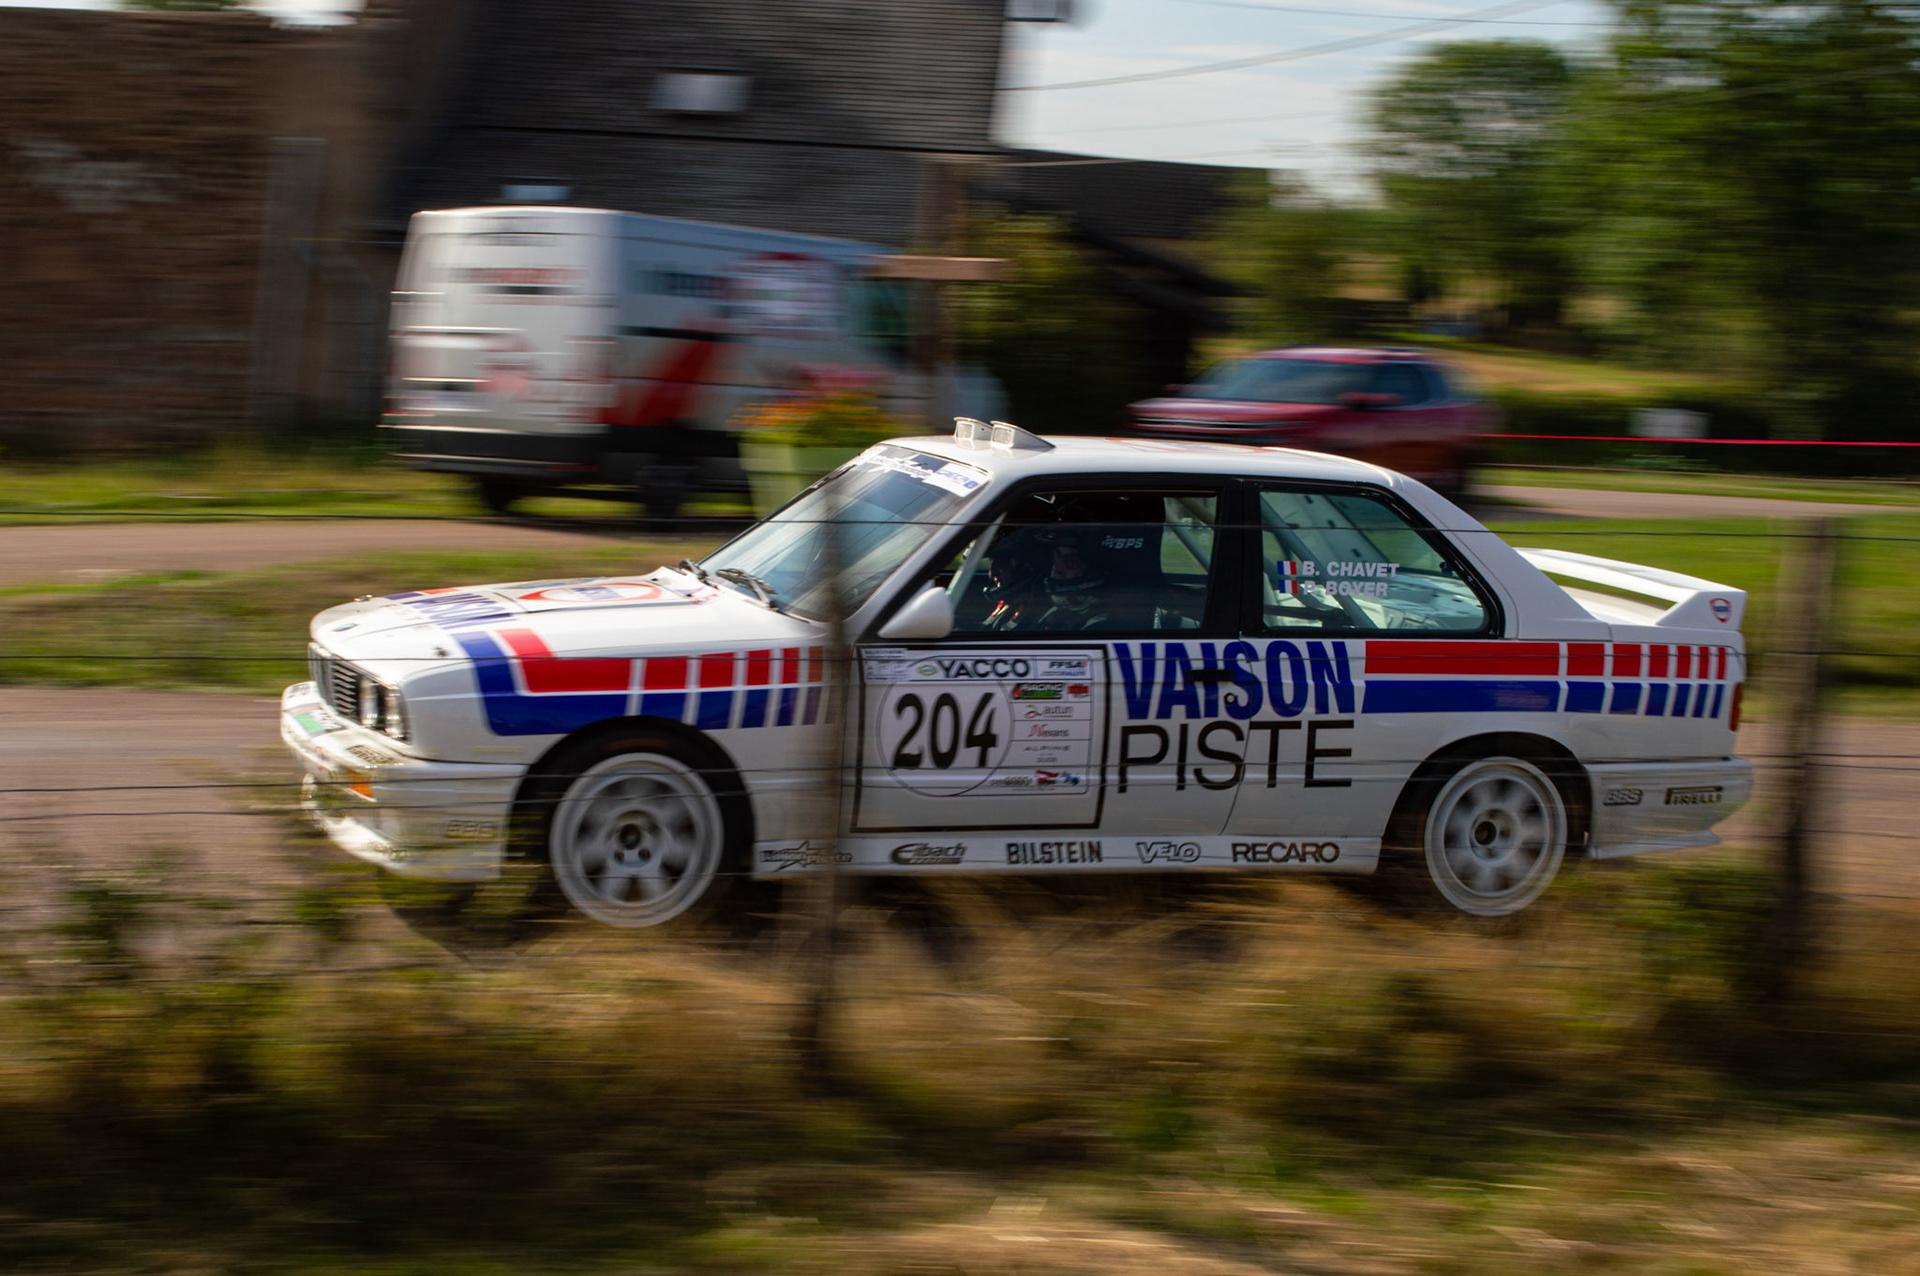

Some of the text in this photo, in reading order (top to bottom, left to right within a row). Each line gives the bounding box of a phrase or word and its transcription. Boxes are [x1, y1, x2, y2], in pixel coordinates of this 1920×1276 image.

[1114, 538, 1145, 549] BPS
[1302, 561, 1400, 578] B. CHAVET
[1325, 581, 1389, 597] BOYER
[937, 659, 1030, 678] YACCO
[1112, 640, 1356, 720] VAISON
[892, 692, 998, 770] 204
[1117, 719, 1355, 795] PISTE
[1664, 786, 1725, 805] PIRELLI
[1006, 841, 1103, 866] BILSTEIN
[1231, 842, 1340, 863] RECARO
